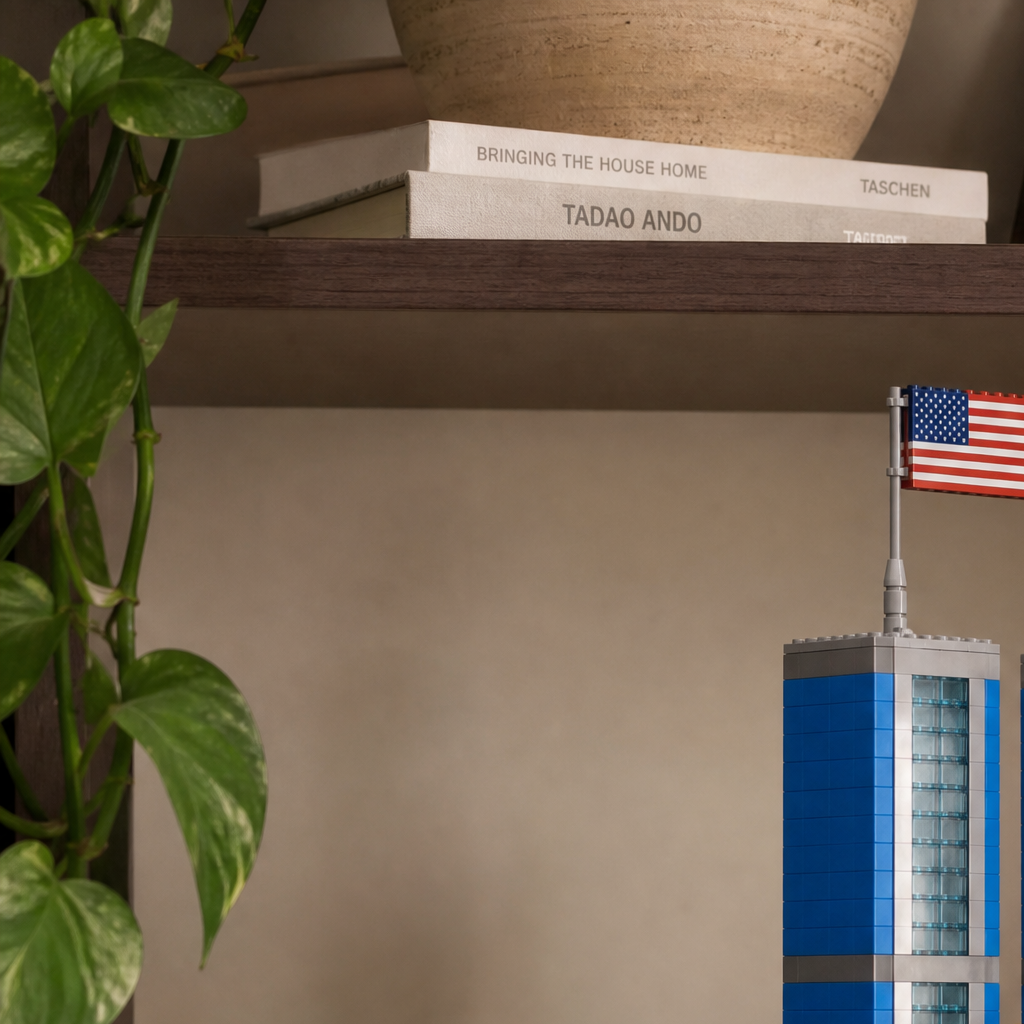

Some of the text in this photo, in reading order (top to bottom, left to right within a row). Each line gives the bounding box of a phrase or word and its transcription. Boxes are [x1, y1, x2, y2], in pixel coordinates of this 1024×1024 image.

[477, 146, 707, 180] BRINGING THE HOUSE HOME
[859, 178, 931, 199] TASCHEN
[561, 203, 702, 234] TADAO ANDO
